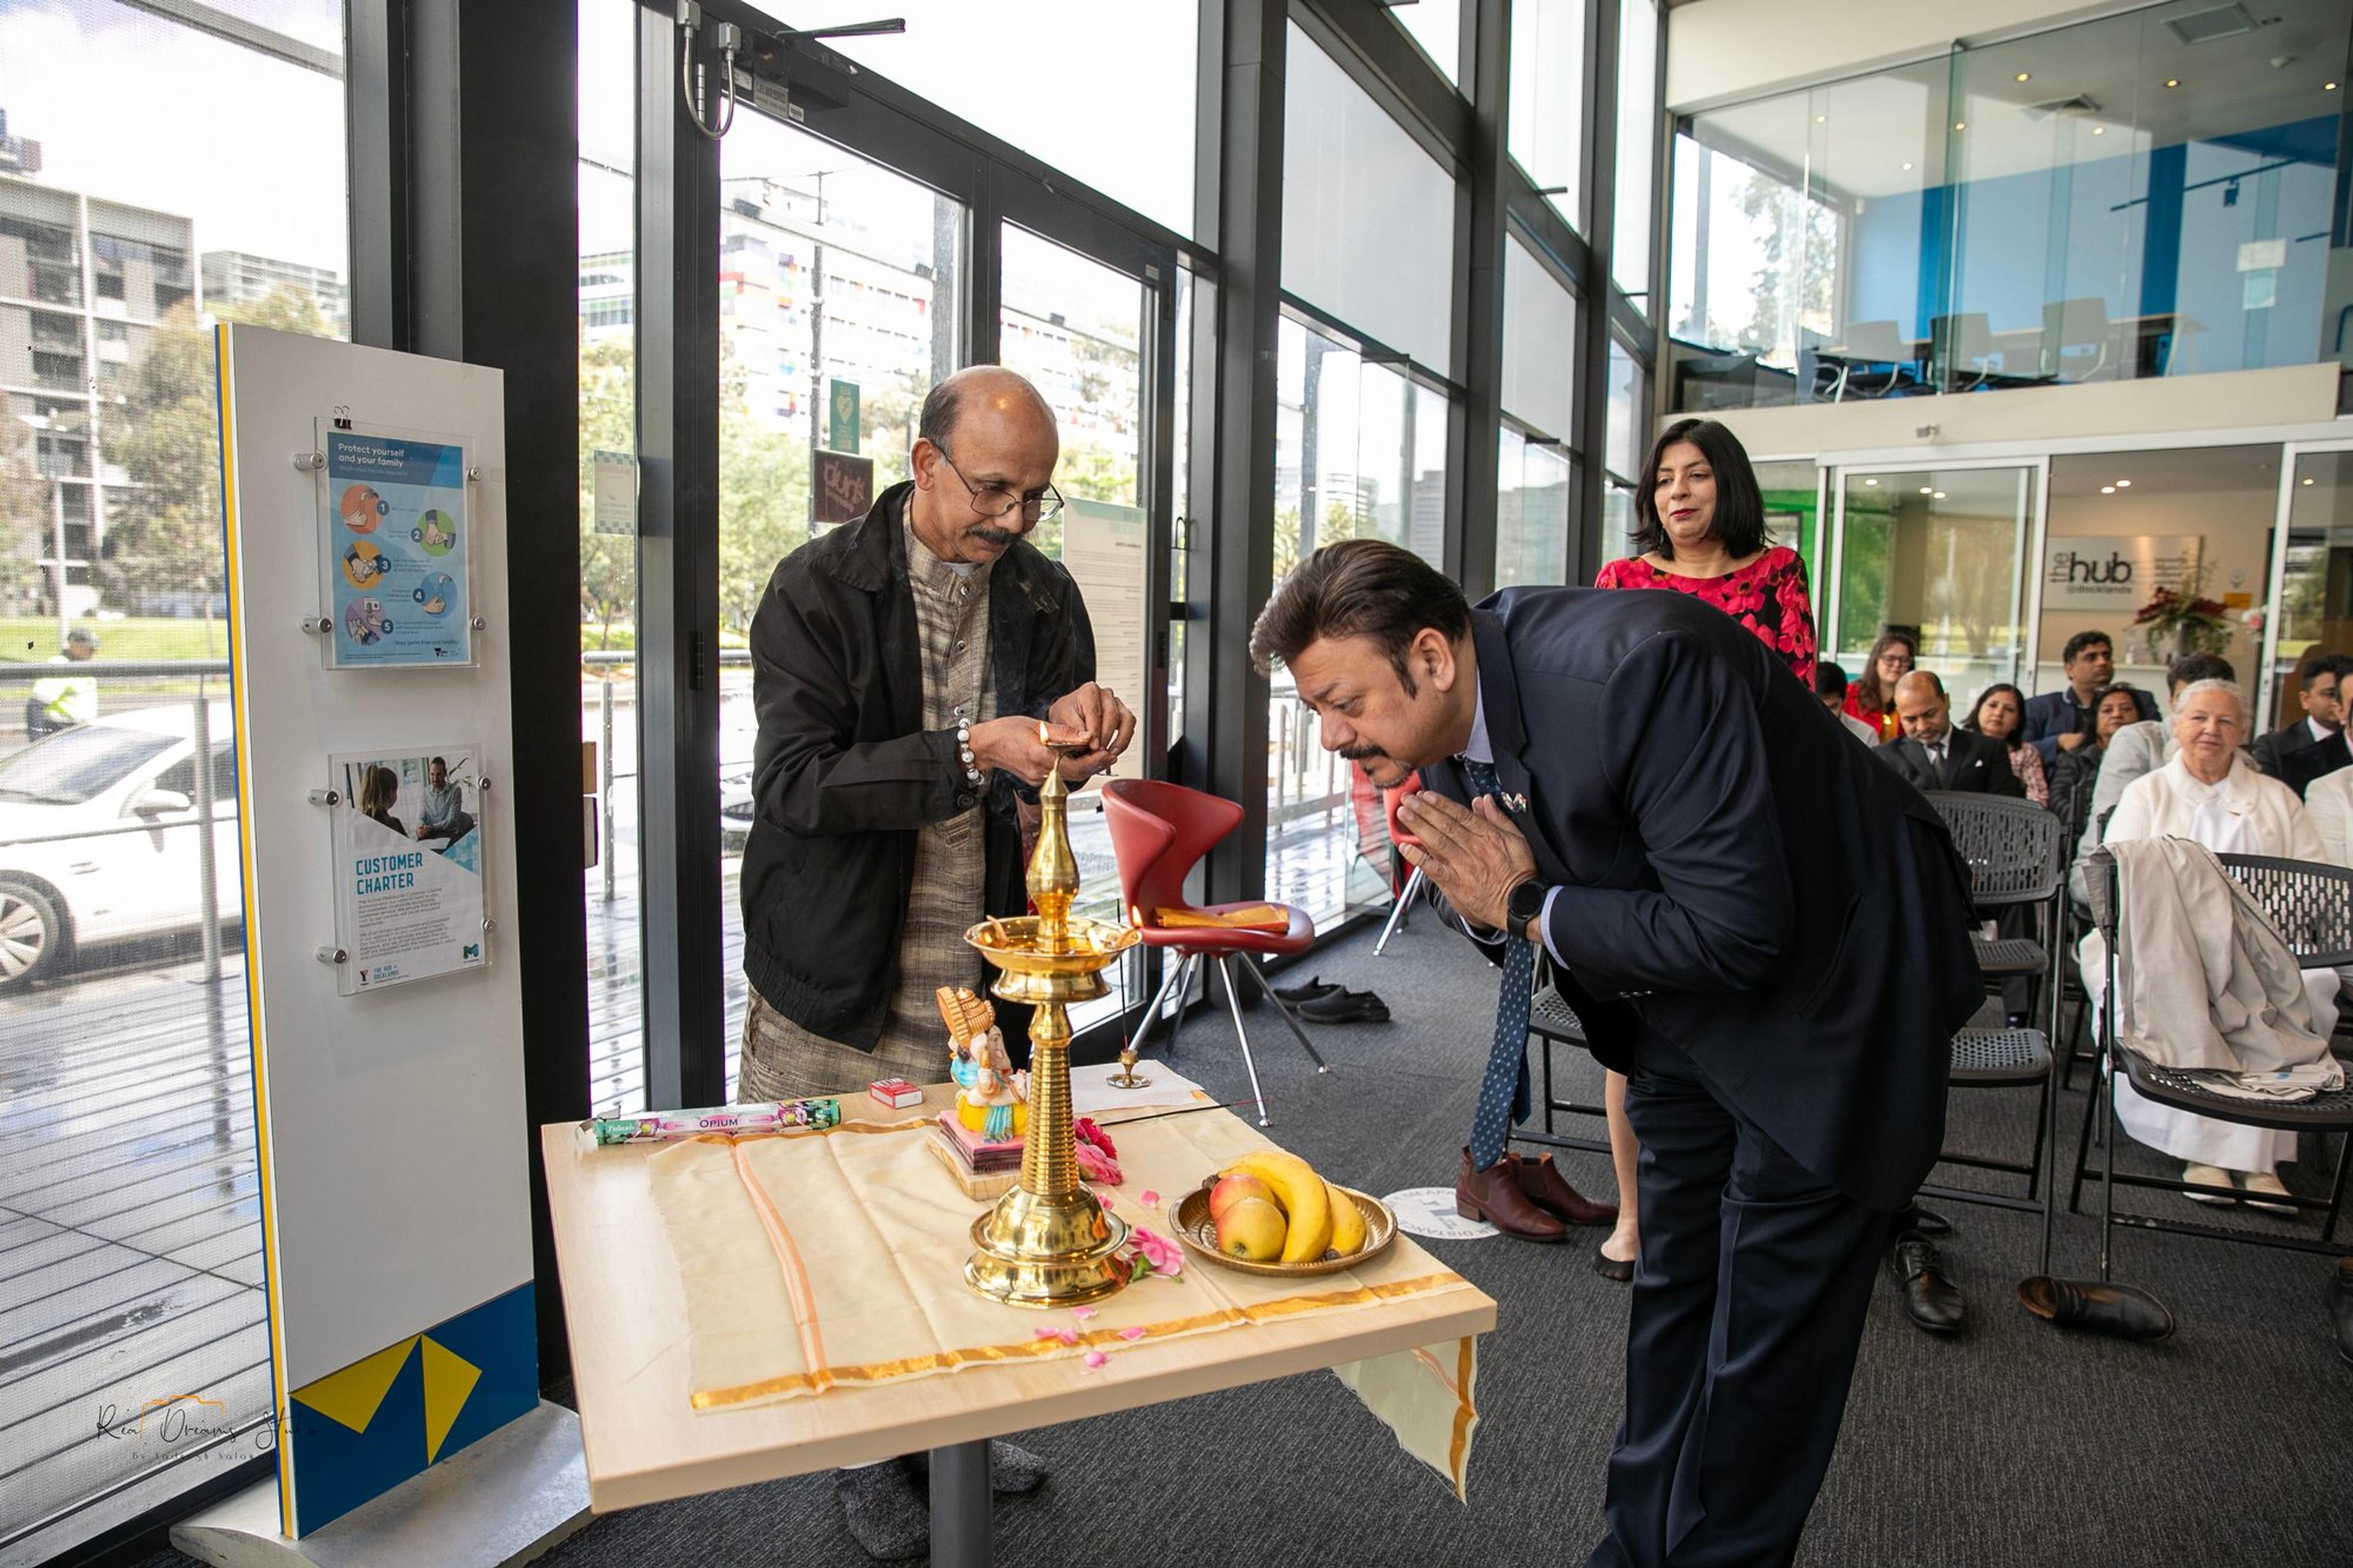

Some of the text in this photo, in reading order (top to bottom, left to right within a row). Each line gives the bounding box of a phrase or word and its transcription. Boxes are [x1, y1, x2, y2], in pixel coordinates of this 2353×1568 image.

[338, 443, 405, 457] Protect yourself
[357, 456, 376, 464] your
[377, 456, 404, 469] family
[2069, 551, 2132, 583] hub
[356, 852, 423, 876] CUSTOMER
[357, 872, 414, 895] CHARTER
[699, 1118, 738, 1128] OPIUM
